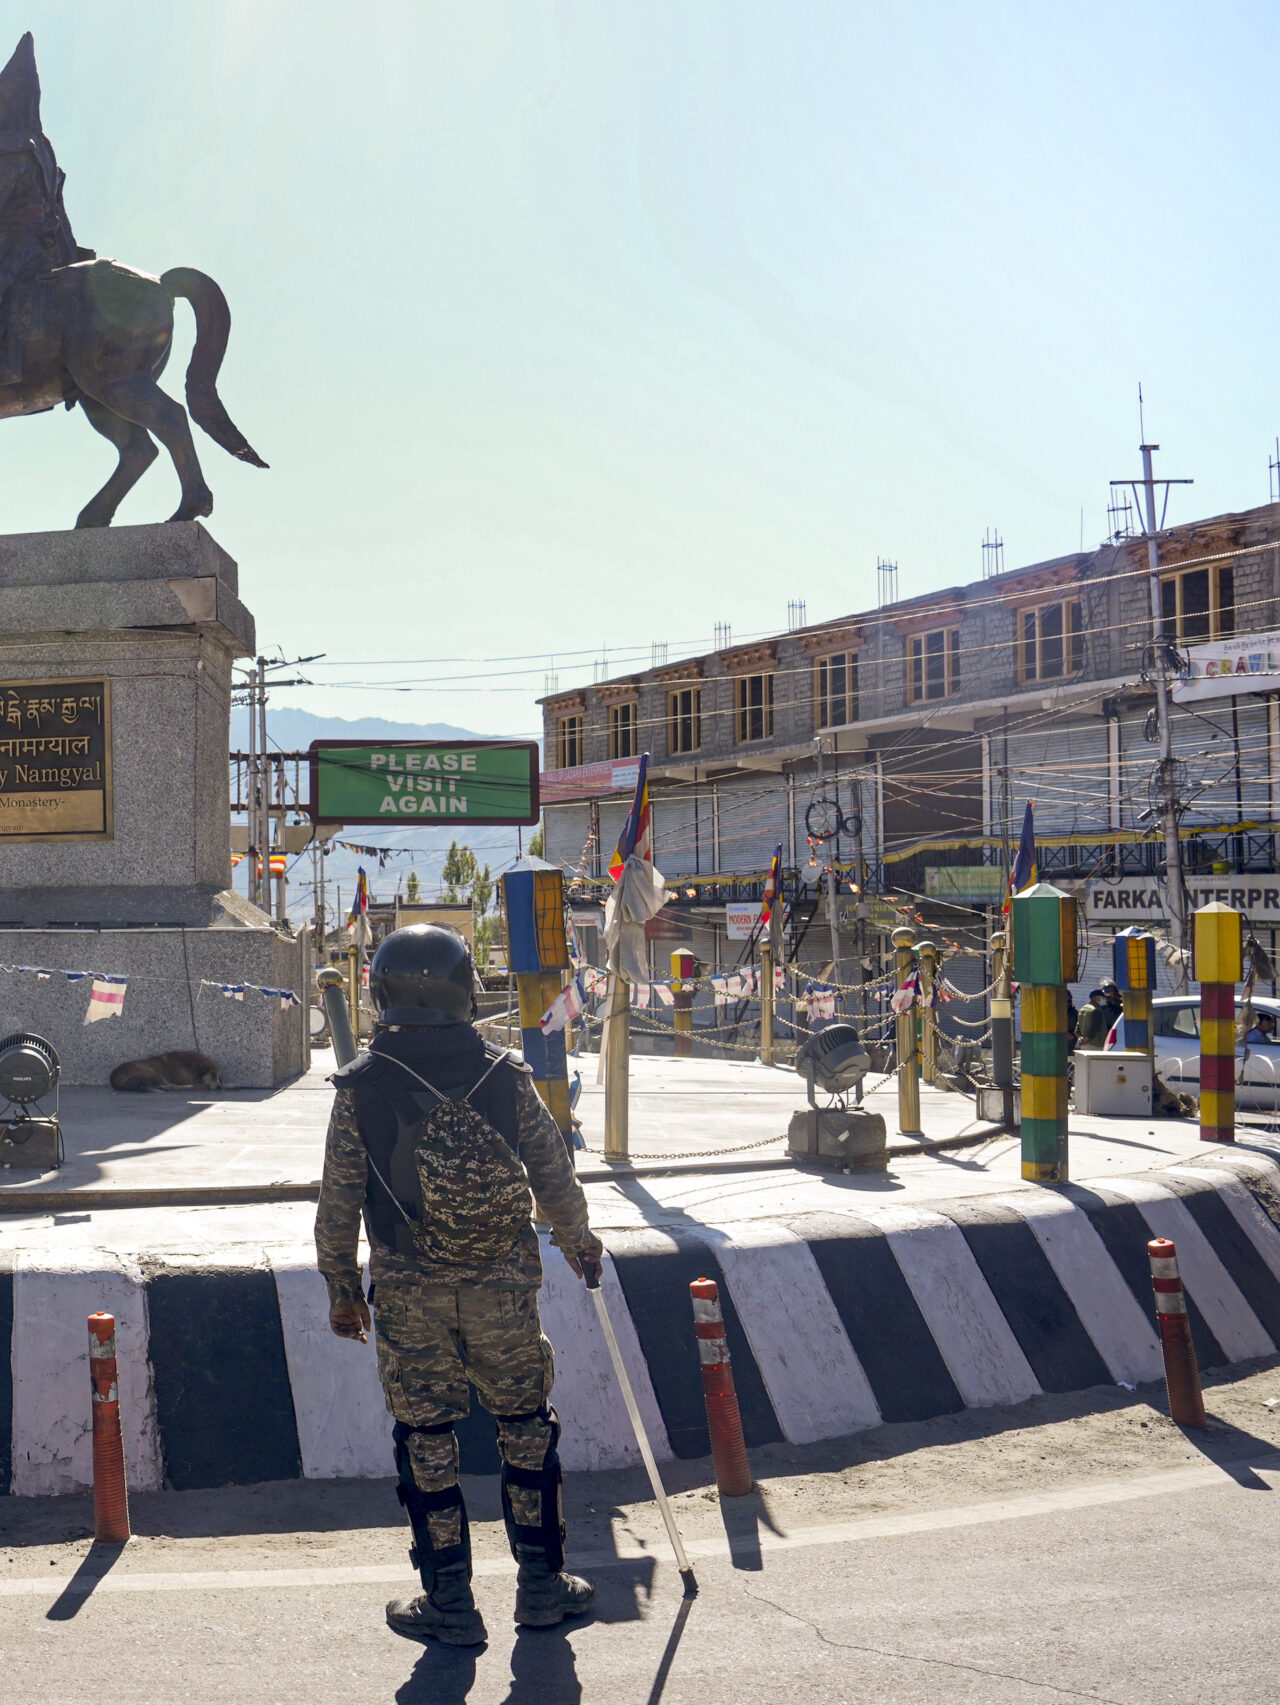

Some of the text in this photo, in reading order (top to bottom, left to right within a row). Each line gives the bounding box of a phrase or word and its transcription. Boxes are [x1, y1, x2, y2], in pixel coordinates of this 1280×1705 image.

[370, 754, 477, 771] PLEASE
[15, 761, 101, 787] Namgyal
[386, 775, 460, 792] VISIT
[0, 796, 66, 811] Monastery-
[379, 796, 467, 813] AGAIN
[729, 914, 752, 925] MODERN
